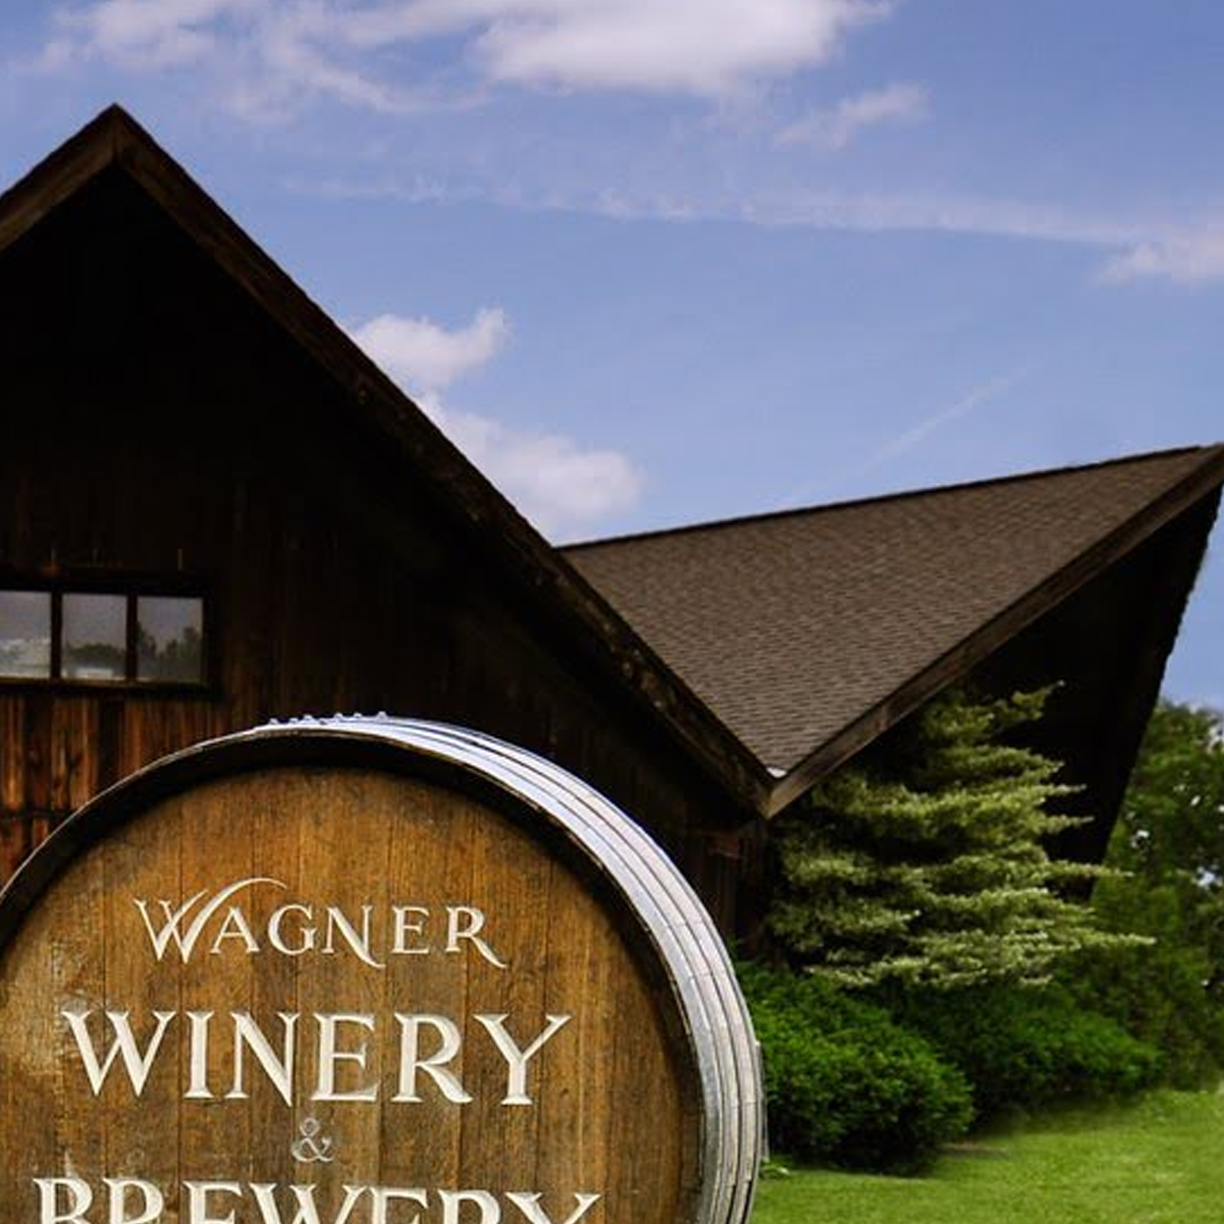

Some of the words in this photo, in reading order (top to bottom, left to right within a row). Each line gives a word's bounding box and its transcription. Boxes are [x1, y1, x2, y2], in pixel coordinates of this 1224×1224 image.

[133, 877, 508, 968] WAGNER
[61, 1010, 572, 1107] WINERY
[290, 1117, 334, 1163] &
